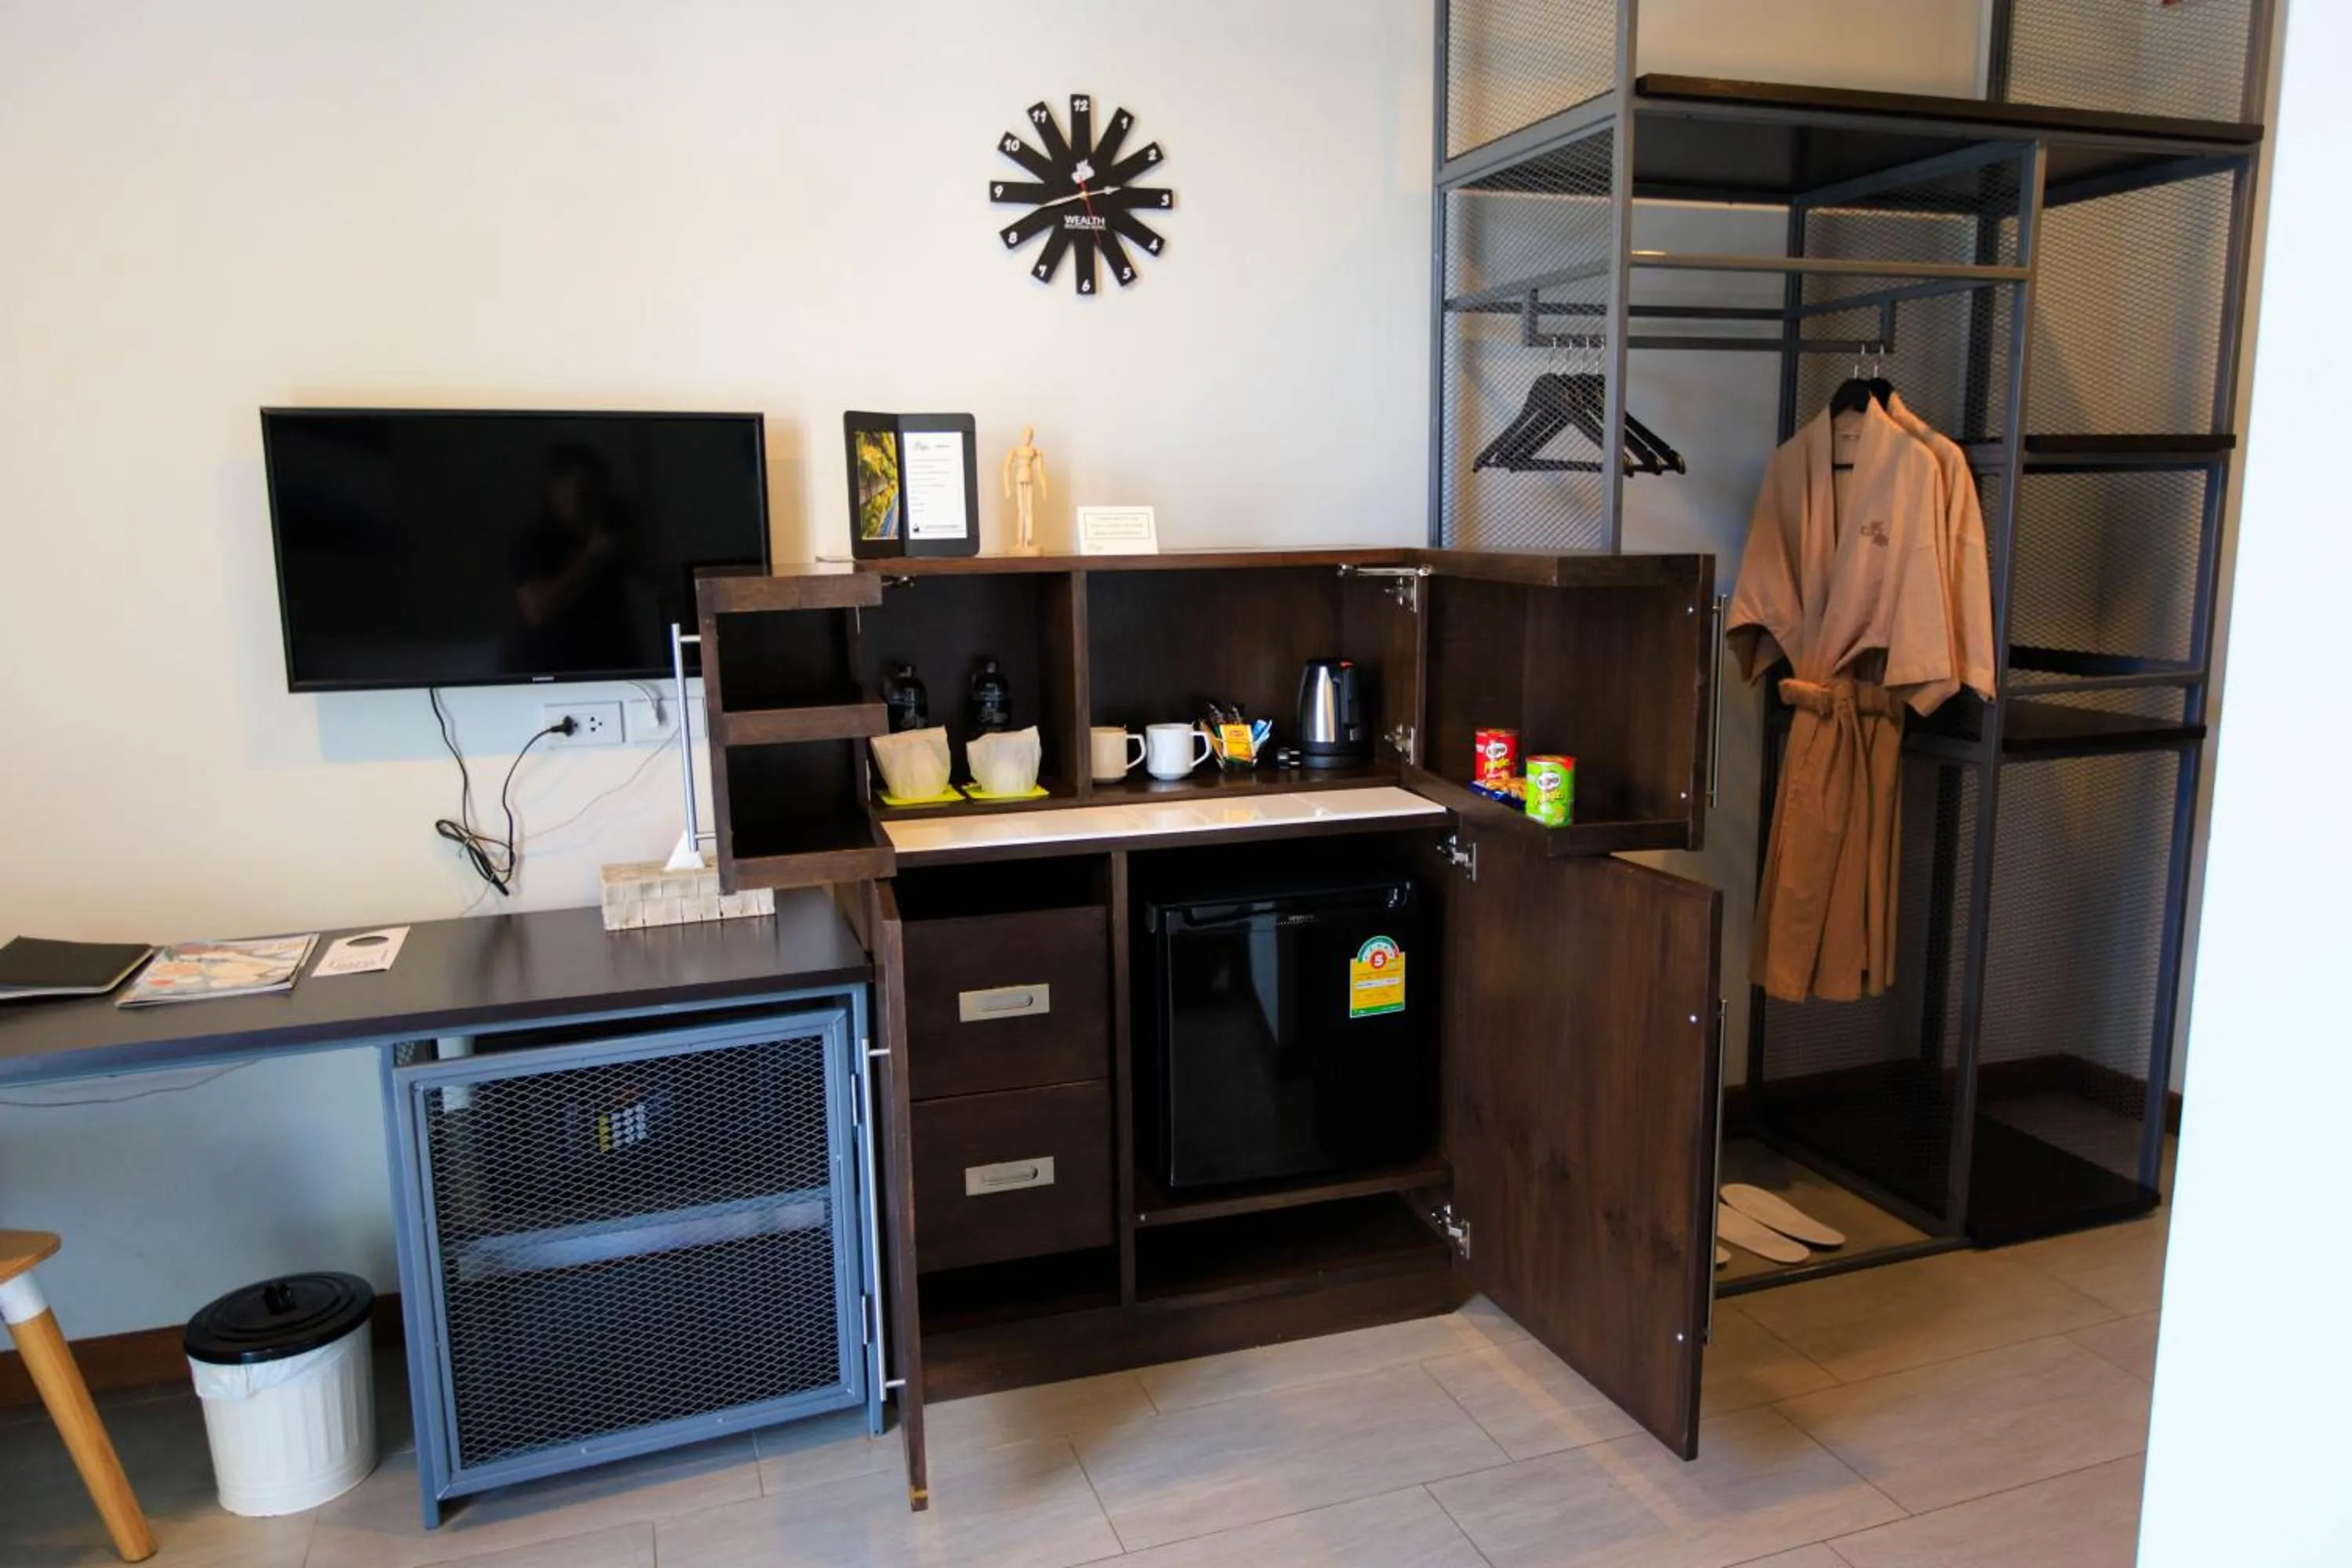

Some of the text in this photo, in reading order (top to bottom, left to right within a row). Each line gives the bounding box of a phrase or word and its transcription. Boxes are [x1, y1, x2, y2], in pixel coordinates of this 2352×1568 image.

[1073, 99, 1090, 111] 12
[1033, 111, 1047, 123] 11
[1121, 118, 1127, 129] 1
[1004, 139, 1020, 151] 10
[1148, 149, 1156, 161] 2
[994, 185, 1004, 198] 9
[1161, 194, 1169, 206] 3
[1064, 215, 1105, 225] WEALTH
[1008, 231, 1017, 243] 8
[1149, 239, 1158, 251] 4
[1039, 265, 1047, 277] 7
[1123, 267, 1131, 278] 5
[1082, 279, 1090, 291] 6
